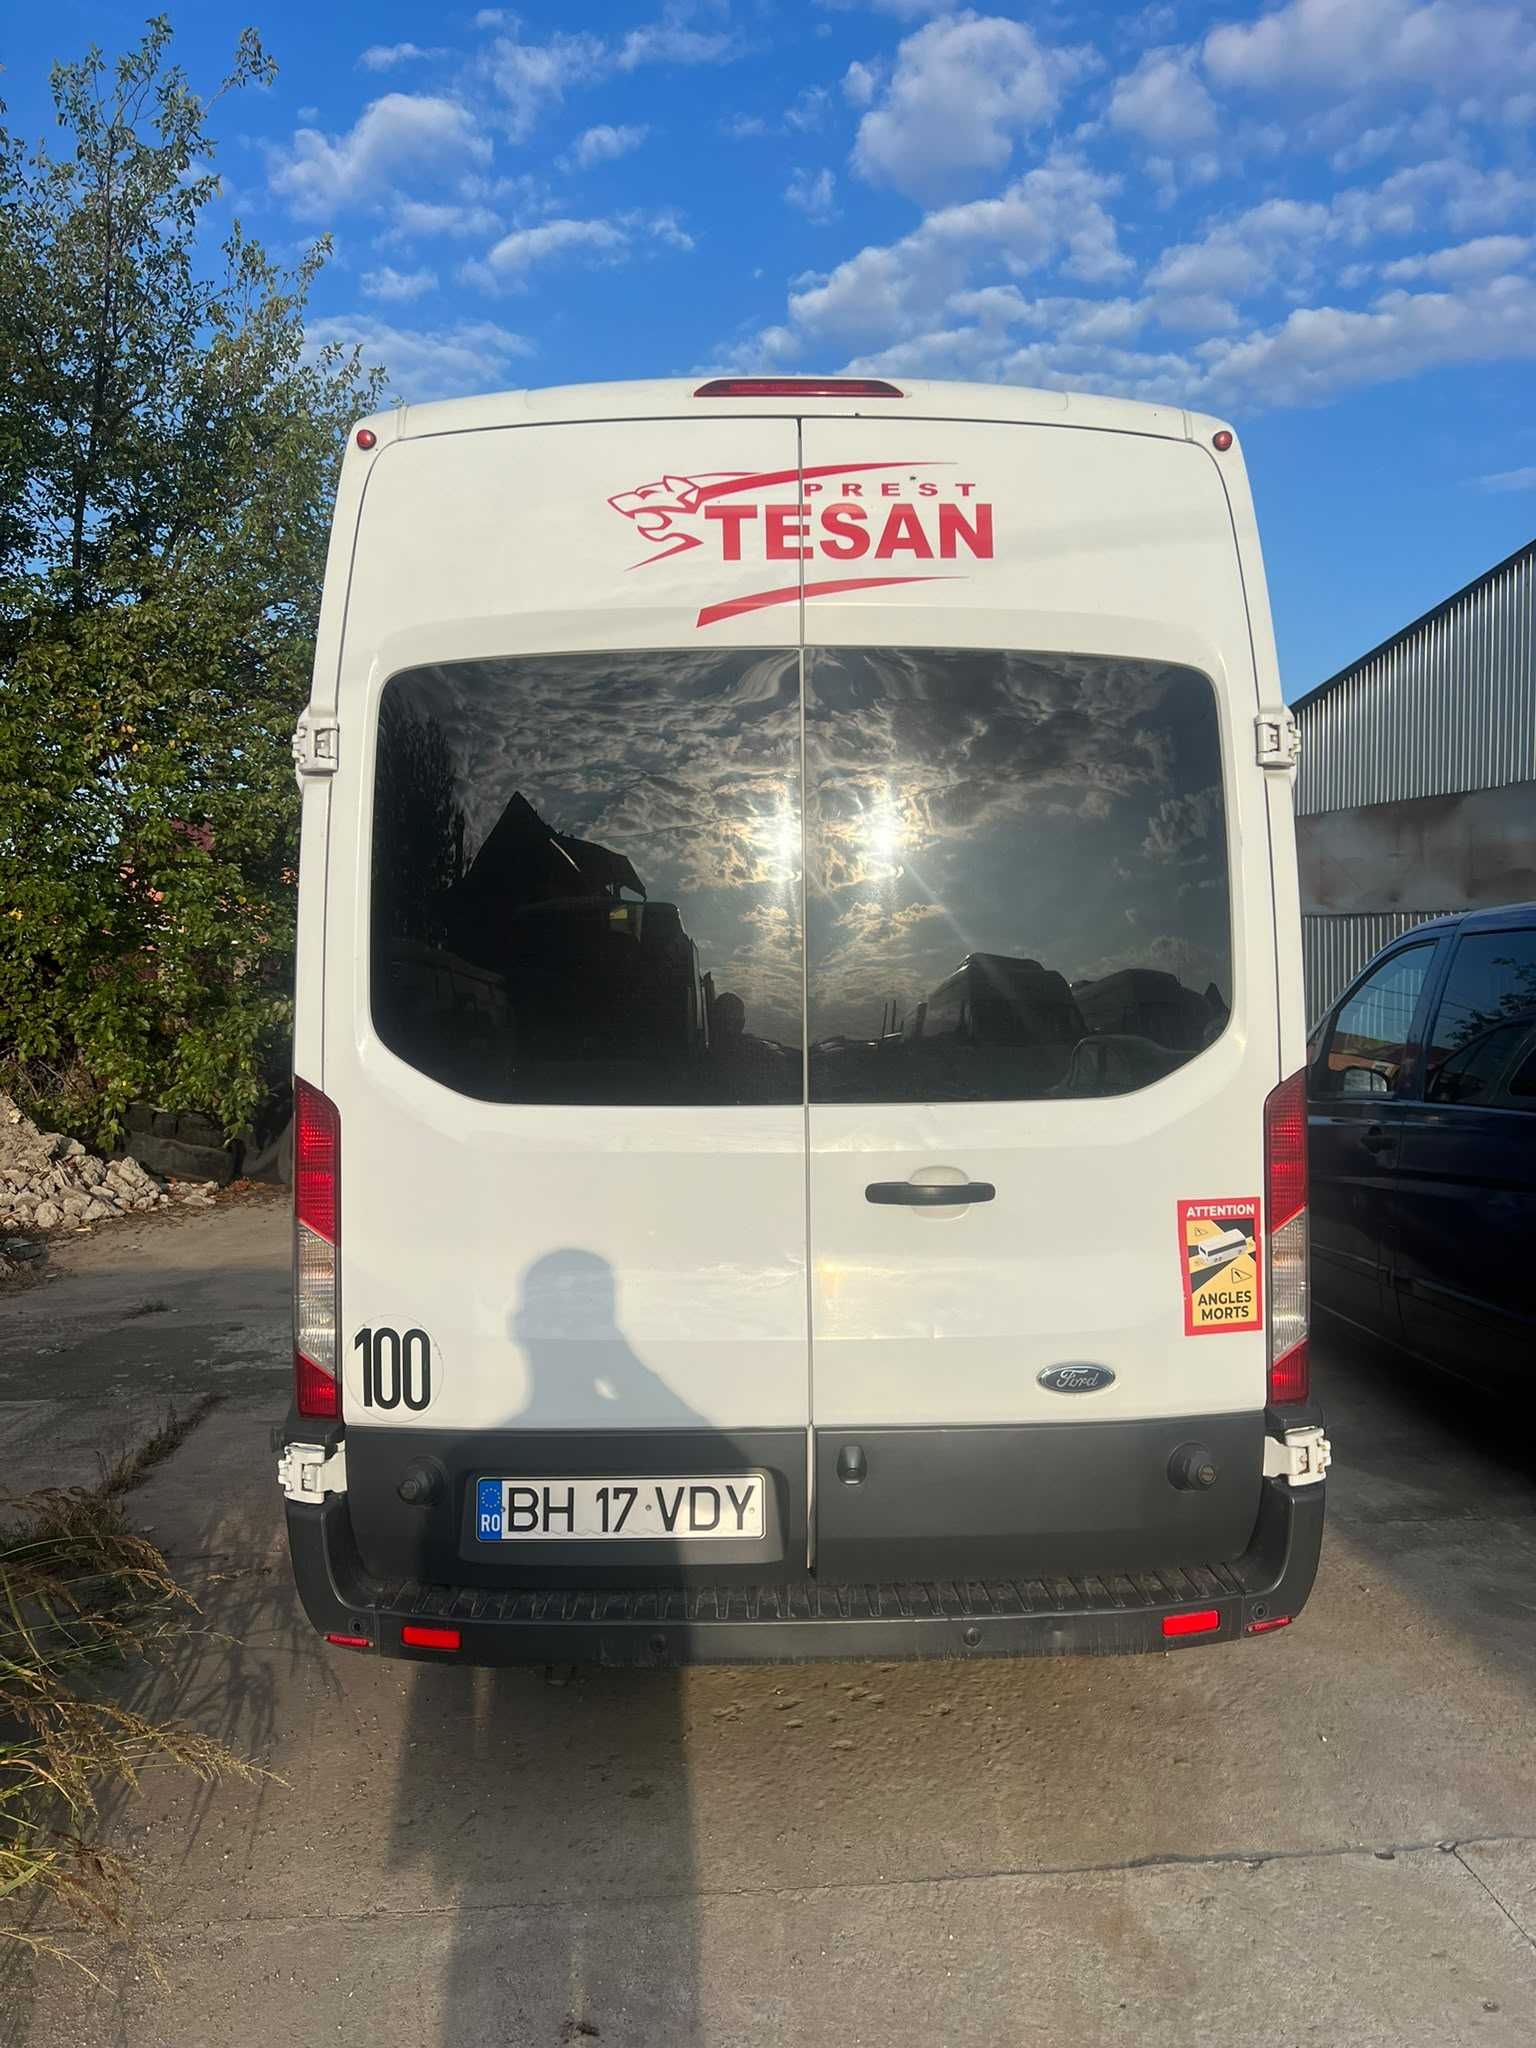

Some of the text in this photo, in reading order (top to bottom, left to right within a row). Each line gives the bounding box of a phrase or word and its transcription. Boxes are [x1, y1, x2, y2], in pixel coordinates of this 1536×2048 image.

[803, 483, 977, 497] PREST
[704, 502, 994, 561] TESAN
[1186, 1203, 1255, 1218] ATTENTION
[1198, 1290, 1252, 1307] ANGLES
[1201, 1305, 1249, 1321] MORTS
[354, 1327, 431, 1411] 100
[1056, 1369, 1100, 1388] Ford
[508, 1485, 755, 1532] BH 17 VDY
[481, 1514, 500, 1532] RO
